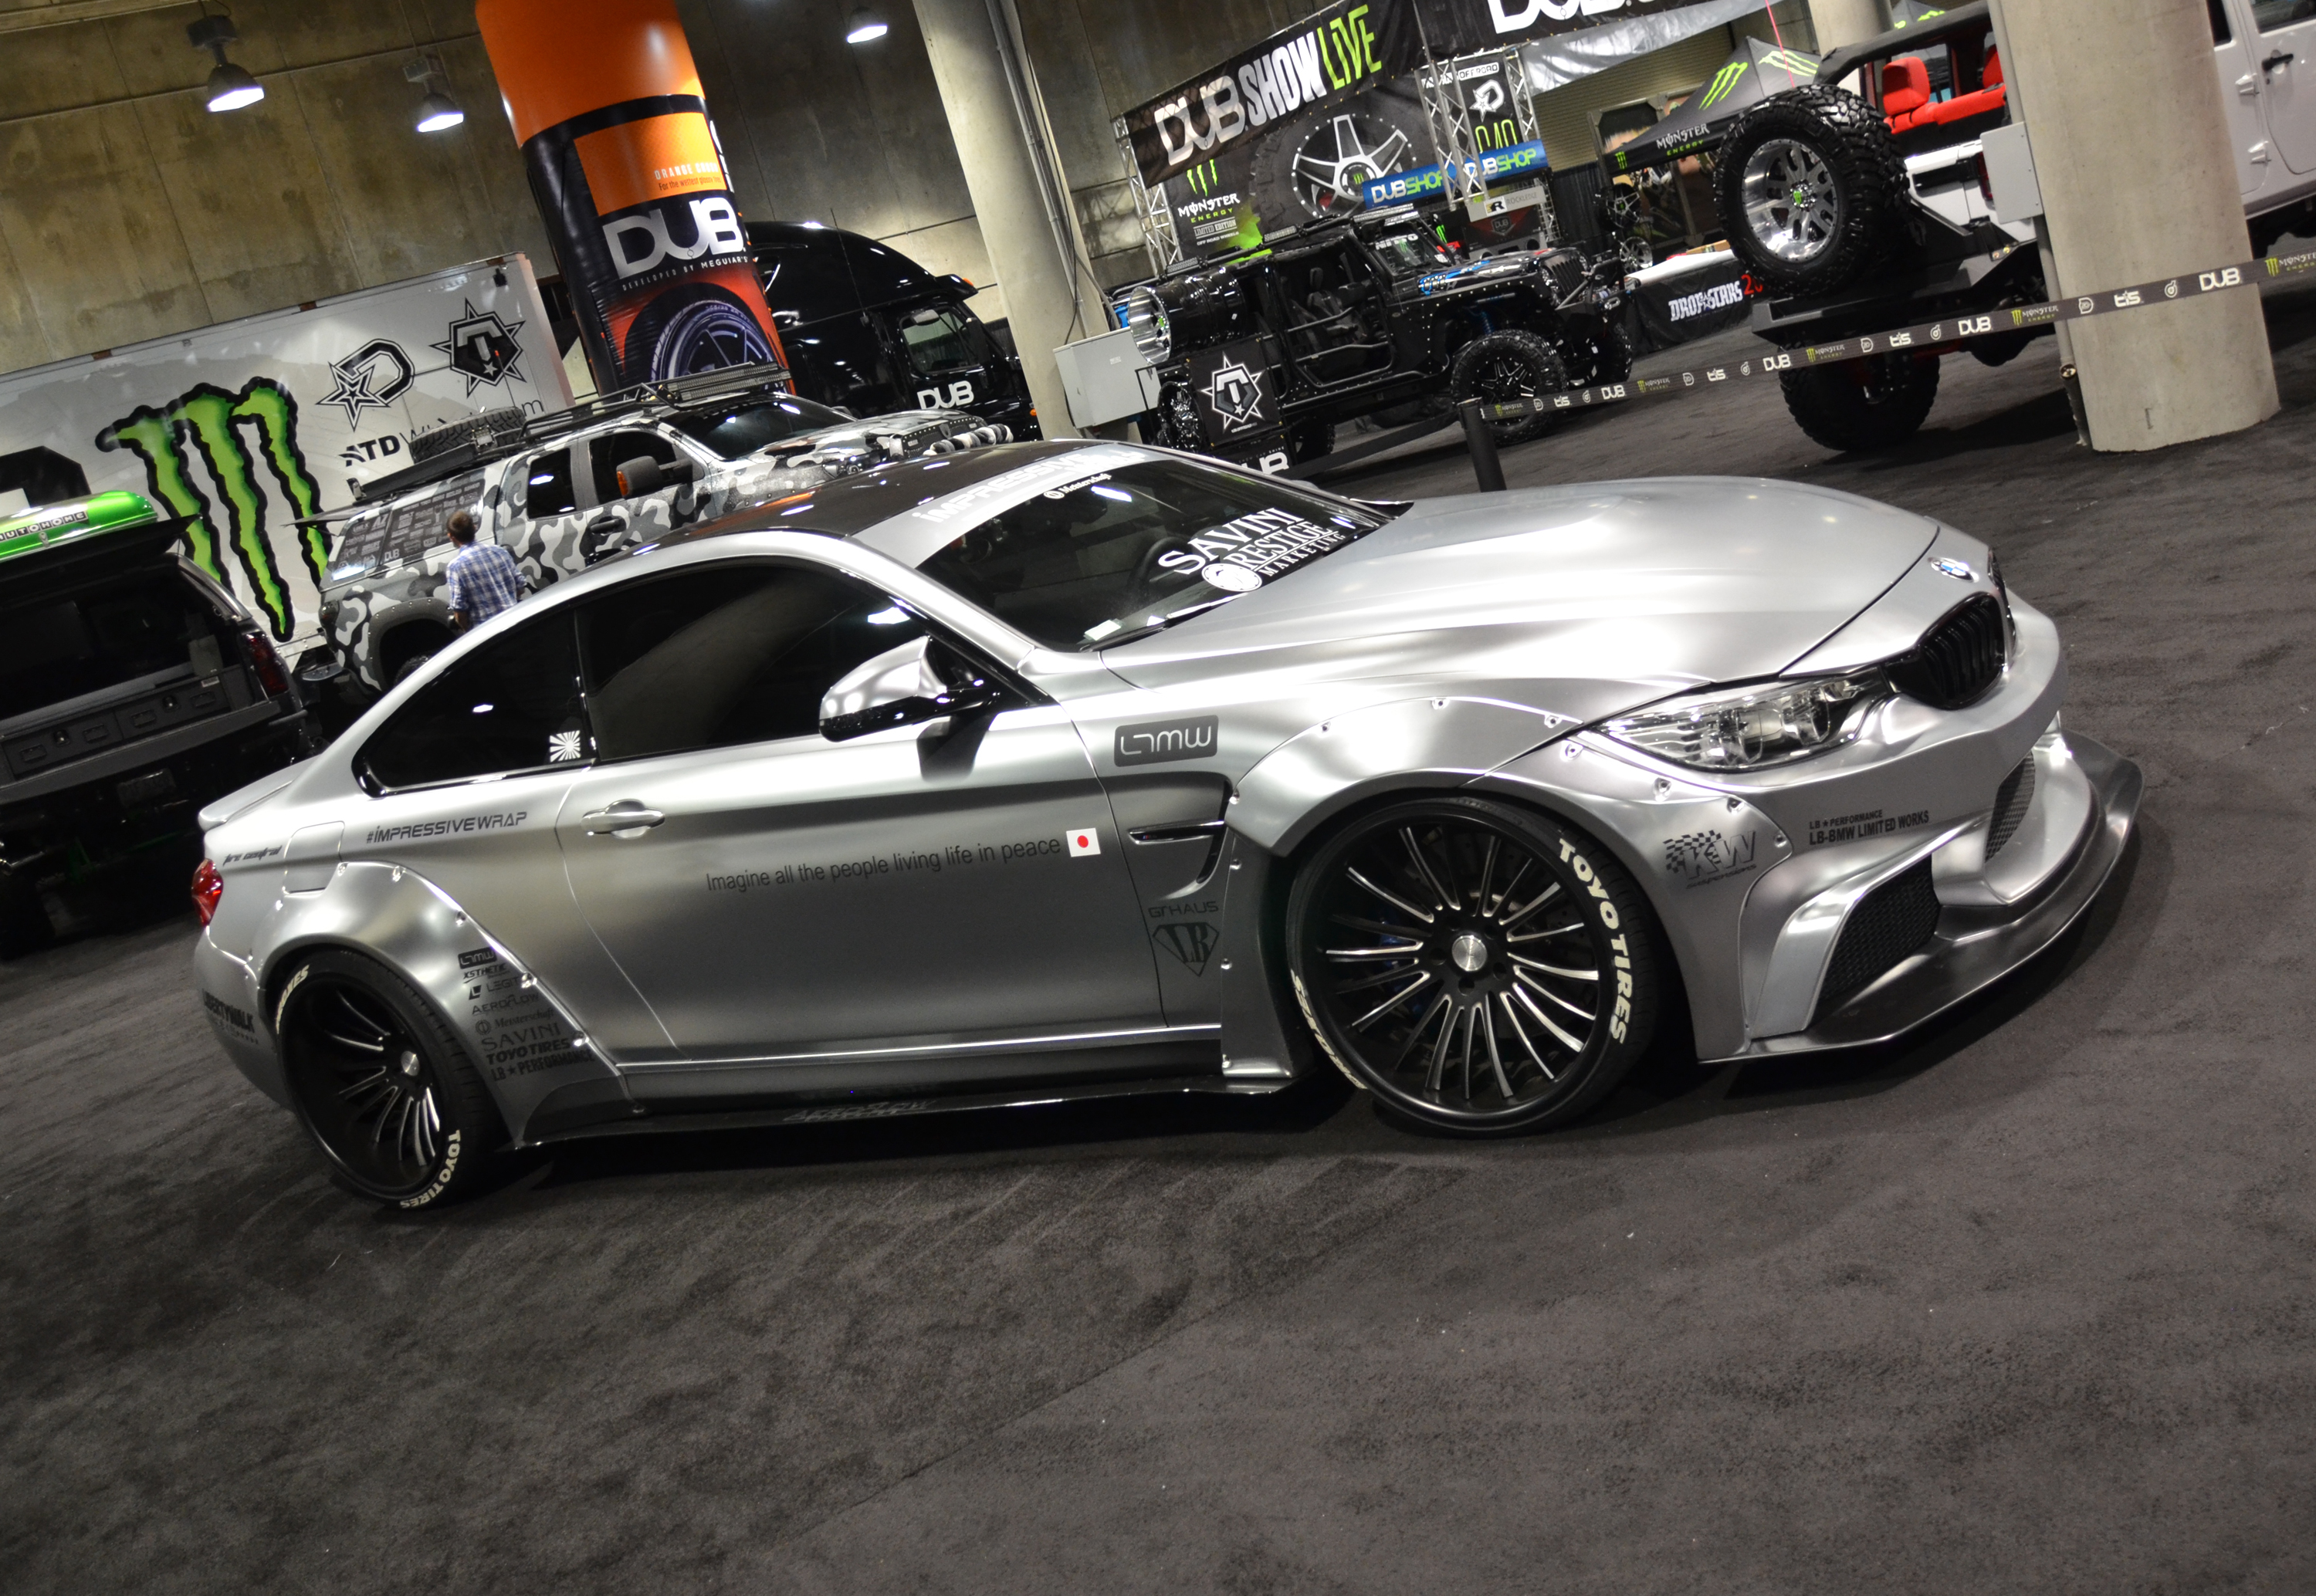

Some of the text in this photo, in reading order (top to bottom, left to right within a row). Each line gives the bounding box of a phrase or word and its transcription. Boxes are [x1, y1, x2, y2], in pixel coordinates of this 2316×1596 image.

[1154, 4, 1383, 166] DUB SHOW LIVE
[1656, 123, 1710, 149] MONSTER
[1666, 140, 1705, 156] ENERGY
[654, 163, 692, 181] ORANGE
[669, 180, 679, 189] the
[1177, 192, 1241, 218] MONSTER
[1190, 208, 1234, 224] ENERGY
[602, 197, 744, 279] DUB
[2279, 252, 2316, 266] MONSTE
[622, 269, 677, 292] DEVELOPED
[701, 255, 749, 269] MEGUIAR'S
[2199, 267, 2240, 292] DUB
[2022, 305, 2059, 319] MONSTER
[1958, 316, 1992, 336] DUB
[1762, 353, 1791, 371] DUB
[916, 380, 974, 410] DUB
[1601, 384, 1626, 400] DUB
[1159, 507, 1305, 575] SAVINI
[1258, 533, 1346, 577] MARKETING
[1809, 810, 1883, 830] LB PERFORMANCE
[1809, 810, 1929, 846] LB-BMW LIMITED WORKS
[706, 837, 1061, 893] Imagine all the people living life in peace
[1682, 830, 1756, 880] KW
[1559, 837, 1633, 1045] TOYO TIRES
[486, 976, 519, 992] LEGIT
[493, 1007, 554, 1029] Meisterschaft
[481, 1023, 562, 1052] SAVINI
[486, 1037, 571, 1065] TOYO TIRES
[399, 1129, 461, 1209] TOYO TIRES
